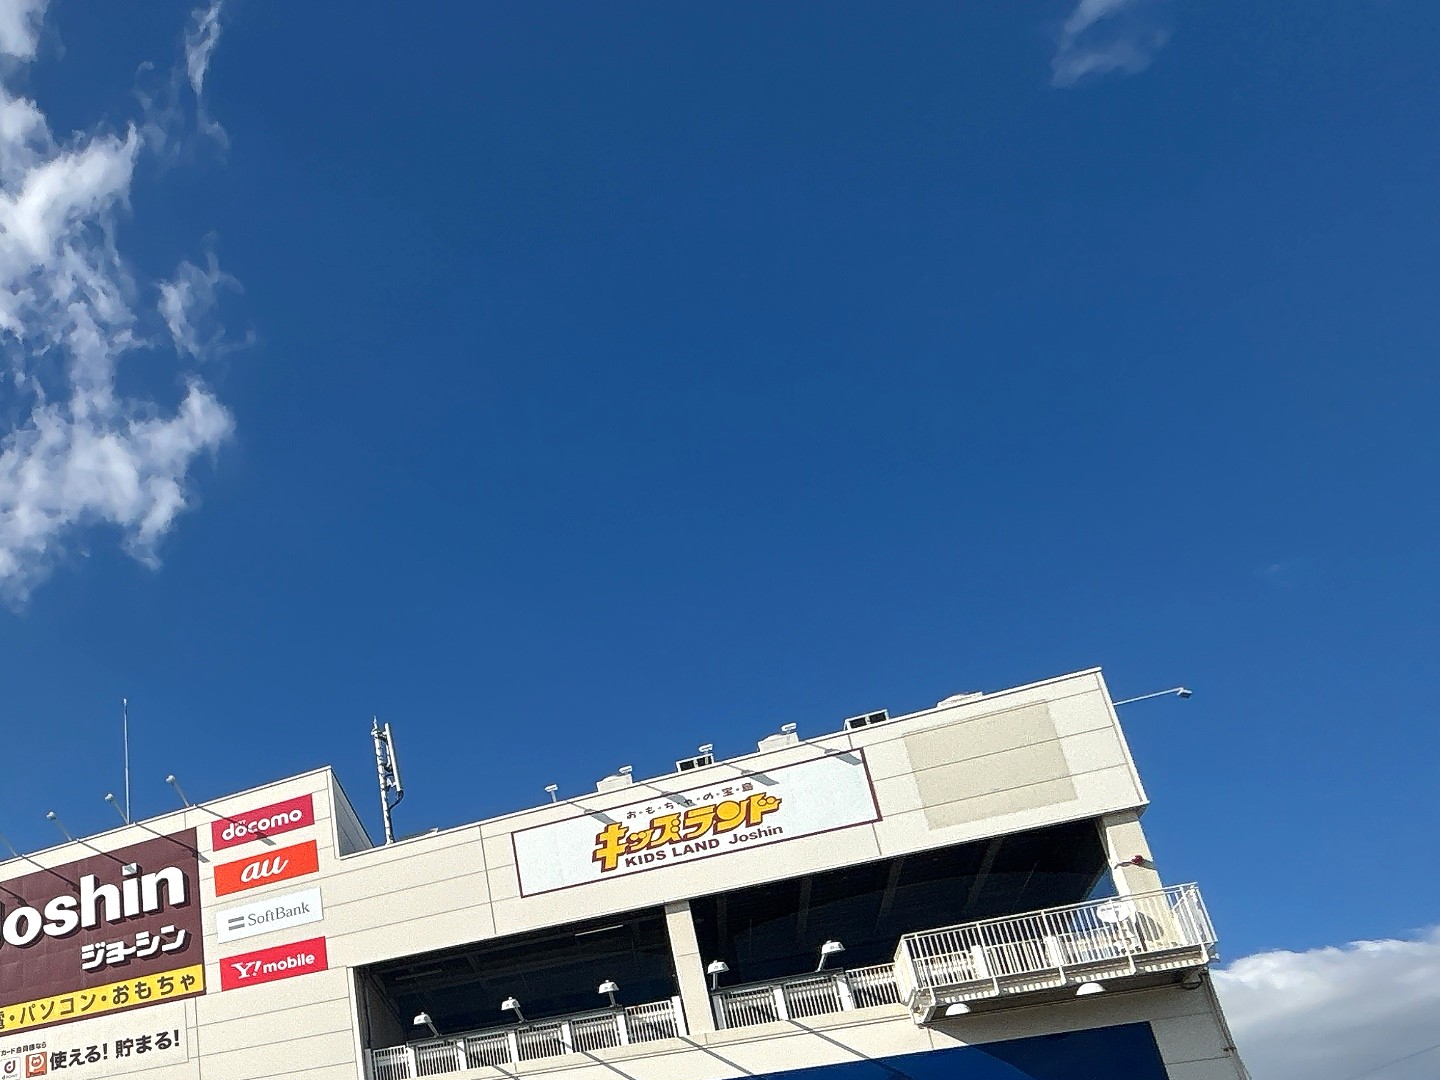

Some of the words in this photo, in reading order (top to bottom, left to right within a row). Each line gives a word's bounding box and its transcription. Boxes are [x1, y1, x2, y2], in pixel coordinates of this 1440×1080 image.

[221, 809, 303, 841] docomo
[592, 791, 782, 873] キッズランド
[625, 850, 667, 868] KIDS
[672, 837, 720, 858] LAND
[728, 825, 783, 845] Joshin
[240, 855, 289, 883] au
[247, 902, 310, 927] SoftBank
[81, 924, 192, 973] ジョーシン
